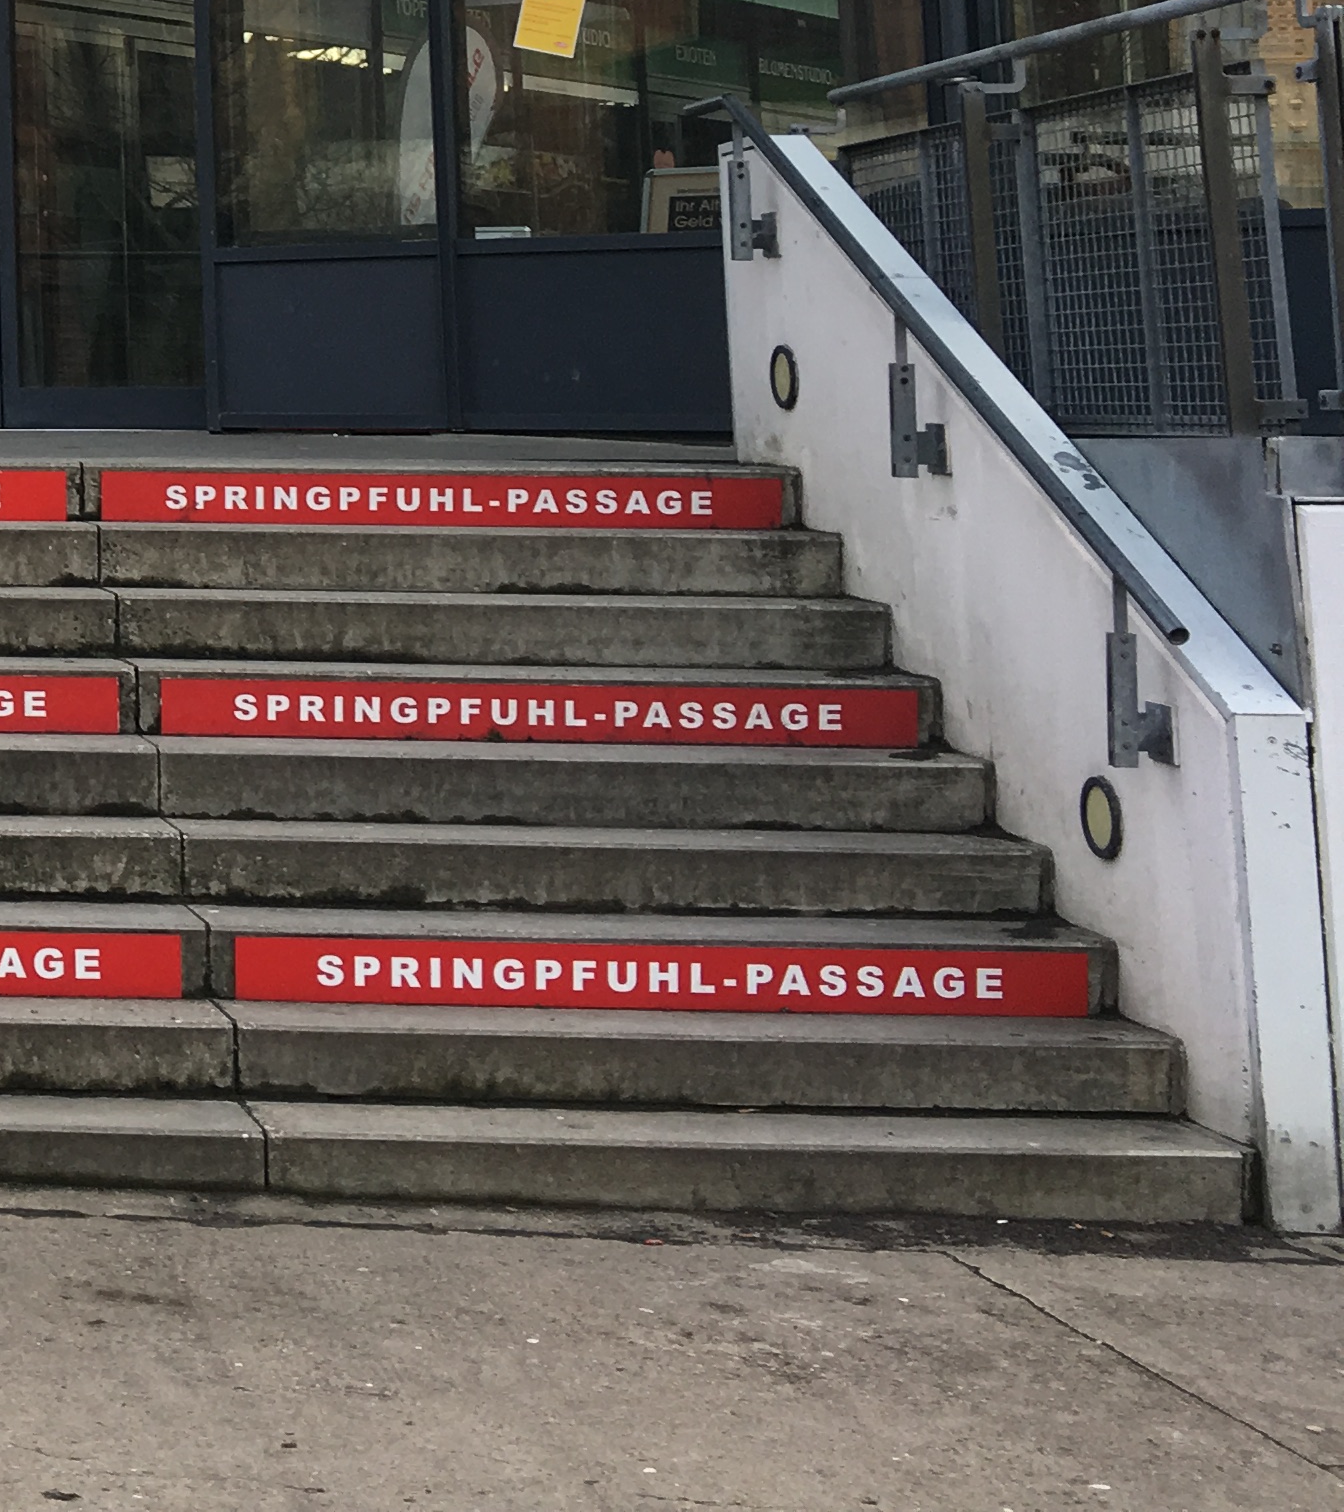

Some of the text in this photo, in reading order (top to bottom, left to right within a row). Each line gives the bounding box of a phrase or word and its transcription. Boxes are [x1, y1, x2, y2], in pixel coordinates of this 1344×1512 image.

[674, 215, 714, 228] Geld
[165, 484, 713, 516] SPRINGPFUHL-PASSAGE
[233, 693, 843, 732] SPRINGPFUHL-PASSAGE
[316, 954, 1003, 999] SPRINGPFUHL-PASSAGE
